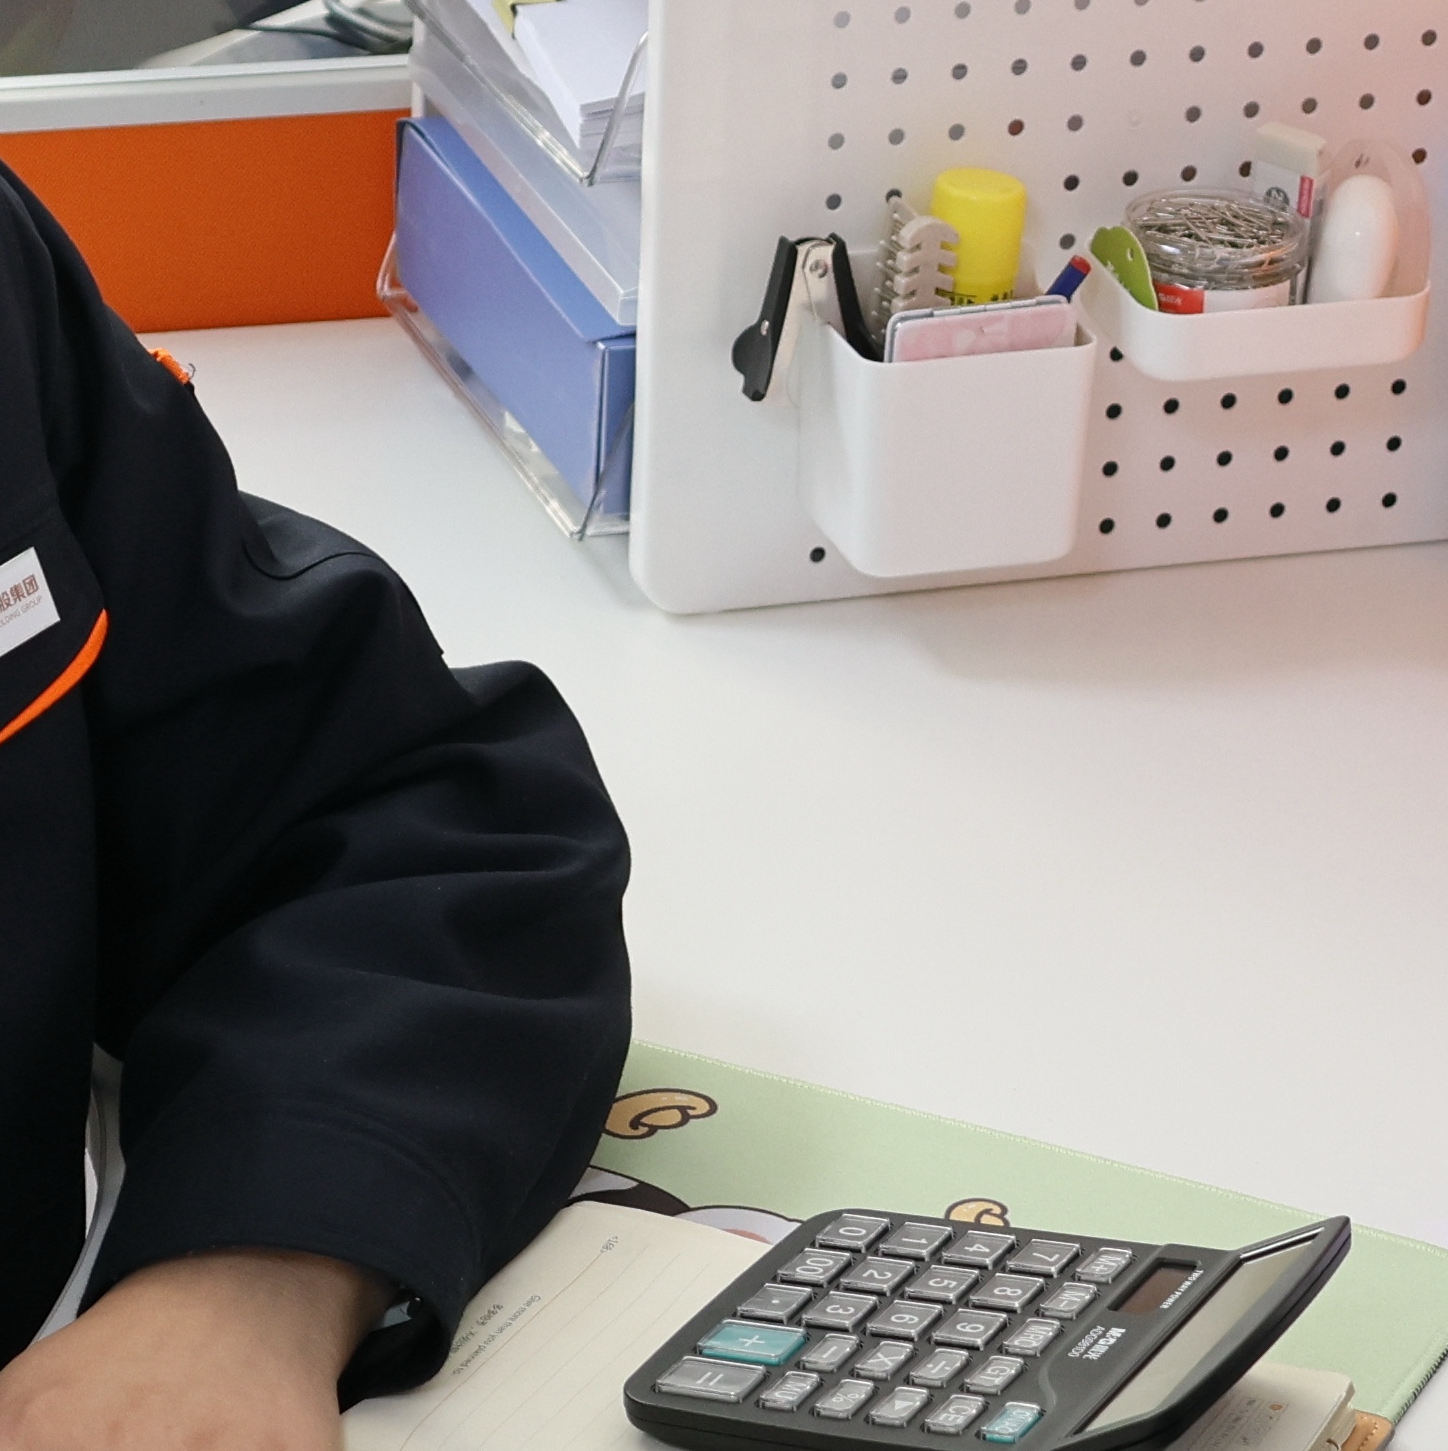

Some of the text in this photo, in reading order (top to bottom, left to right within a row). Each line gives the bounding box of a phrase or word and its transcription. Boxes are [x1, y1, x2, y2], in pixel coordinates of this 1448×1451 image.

[21, 596, 43, 613] GROUP
[901, 1237, 928, 1246] 1
[964, 1243, 990, 1253] 4
[1032, 1251, 1061, 1262] 7
[795, 1257, 834, 1276] 00
[1094, 1255, 1120, 1273] M+
[862, 1269, 892, 1280] 2
[928, 1277, 958, 1288] 5
[993, 1285, 1023, 1296] 8
[1159, 1269, 1204, 1310] TWO WAY POWER
[825, 1304, 854, 1315] 3
[890, 1313, 919, 1325] 6
[956, 1322, 985, 1332] 9
[1013, 1325, 1052, 1347] MRC
[985, 1365, 1010, 1385] GT
[774, 1380, 808, 1399] MU
[942, 1405, 972, 1423] CE
